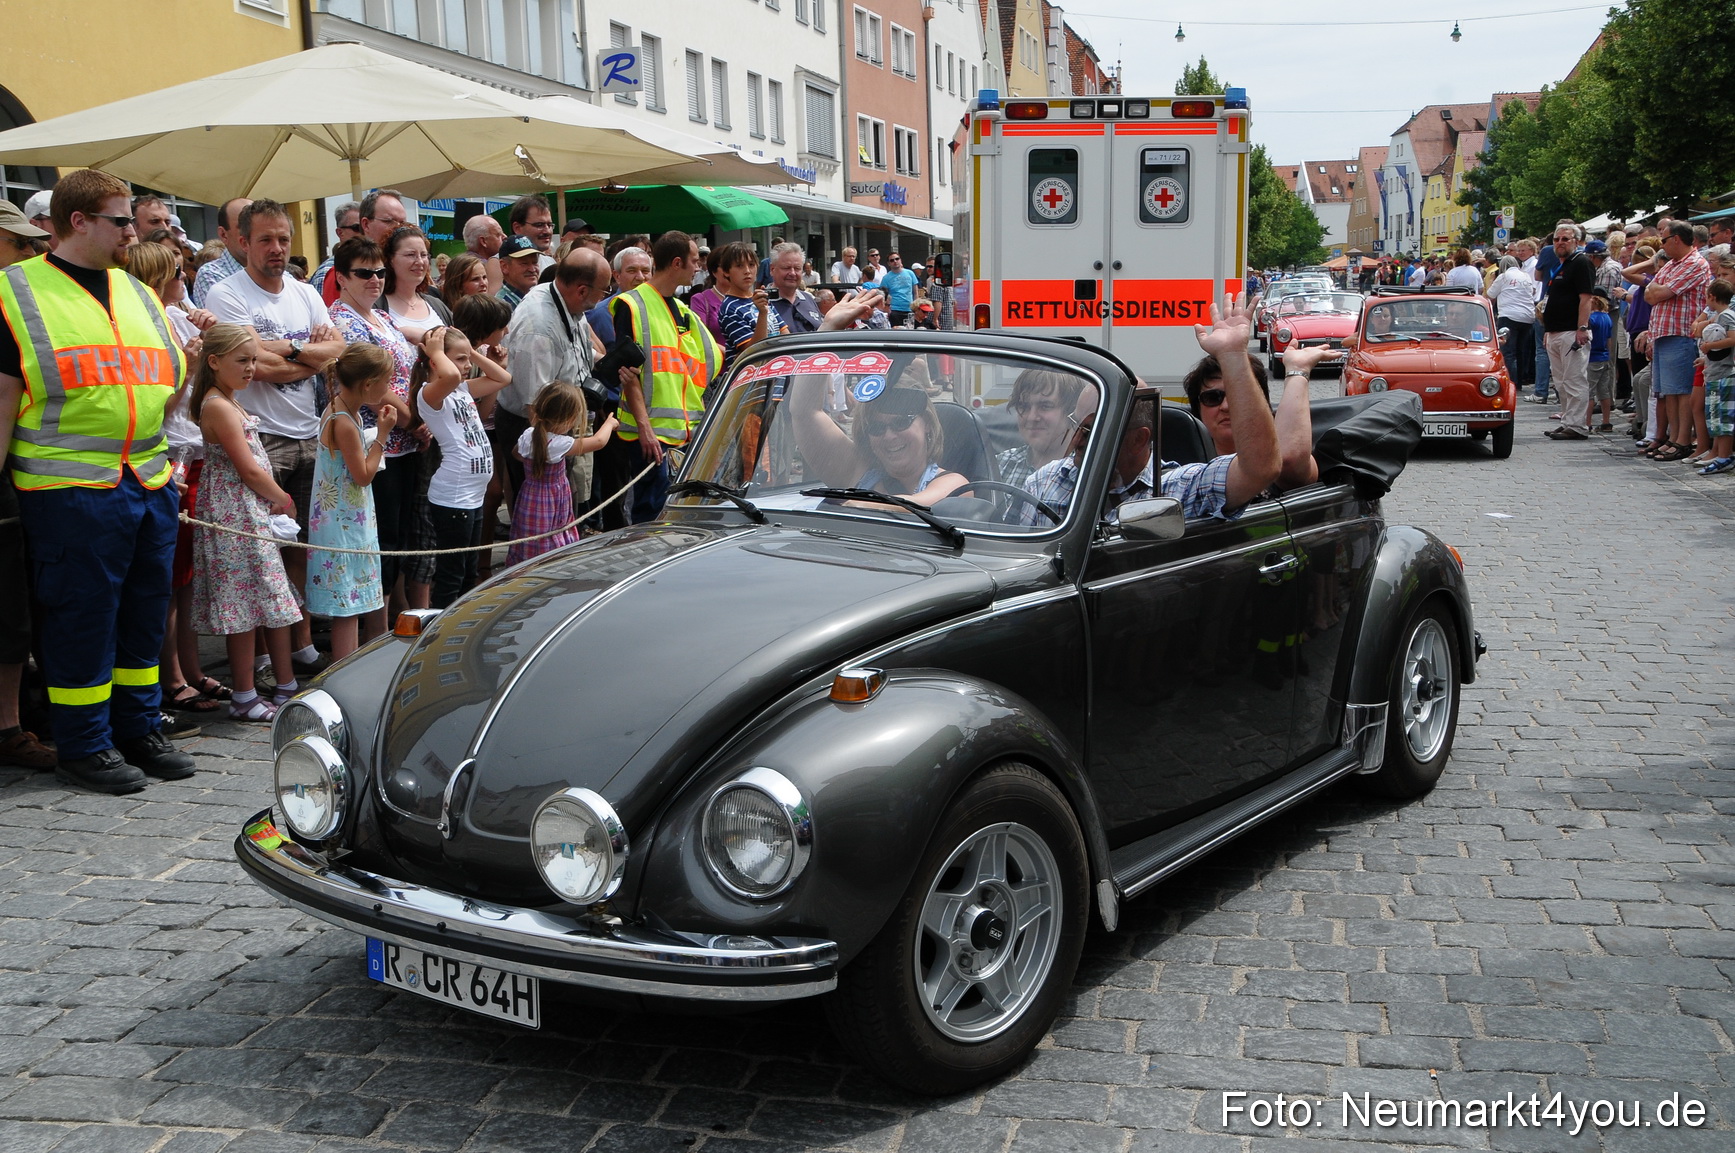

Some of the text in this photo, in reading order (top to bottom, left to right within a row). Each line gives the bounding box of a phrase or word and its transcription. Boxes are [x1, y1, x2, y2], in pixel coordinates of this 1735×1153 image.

[1036, 181, 1070, 197] BAYERISCHES
[1148, 180, 1181, 197] BAYERISCHES
[1036, 199, 1070, 215] ROTES KREUZ
[1148, 198, 1181, 215] ROTES KREUZ
[1007, 301, 1206, 319] RETTUNGSDIENST
[57, 348, 159, 384] THW
[861, 381, 877, 396] C
[1437, 424, 1466, 436] 500H
[373, 959, 379, 971] D
[384, 944, 534, 1020] R CR 64H
